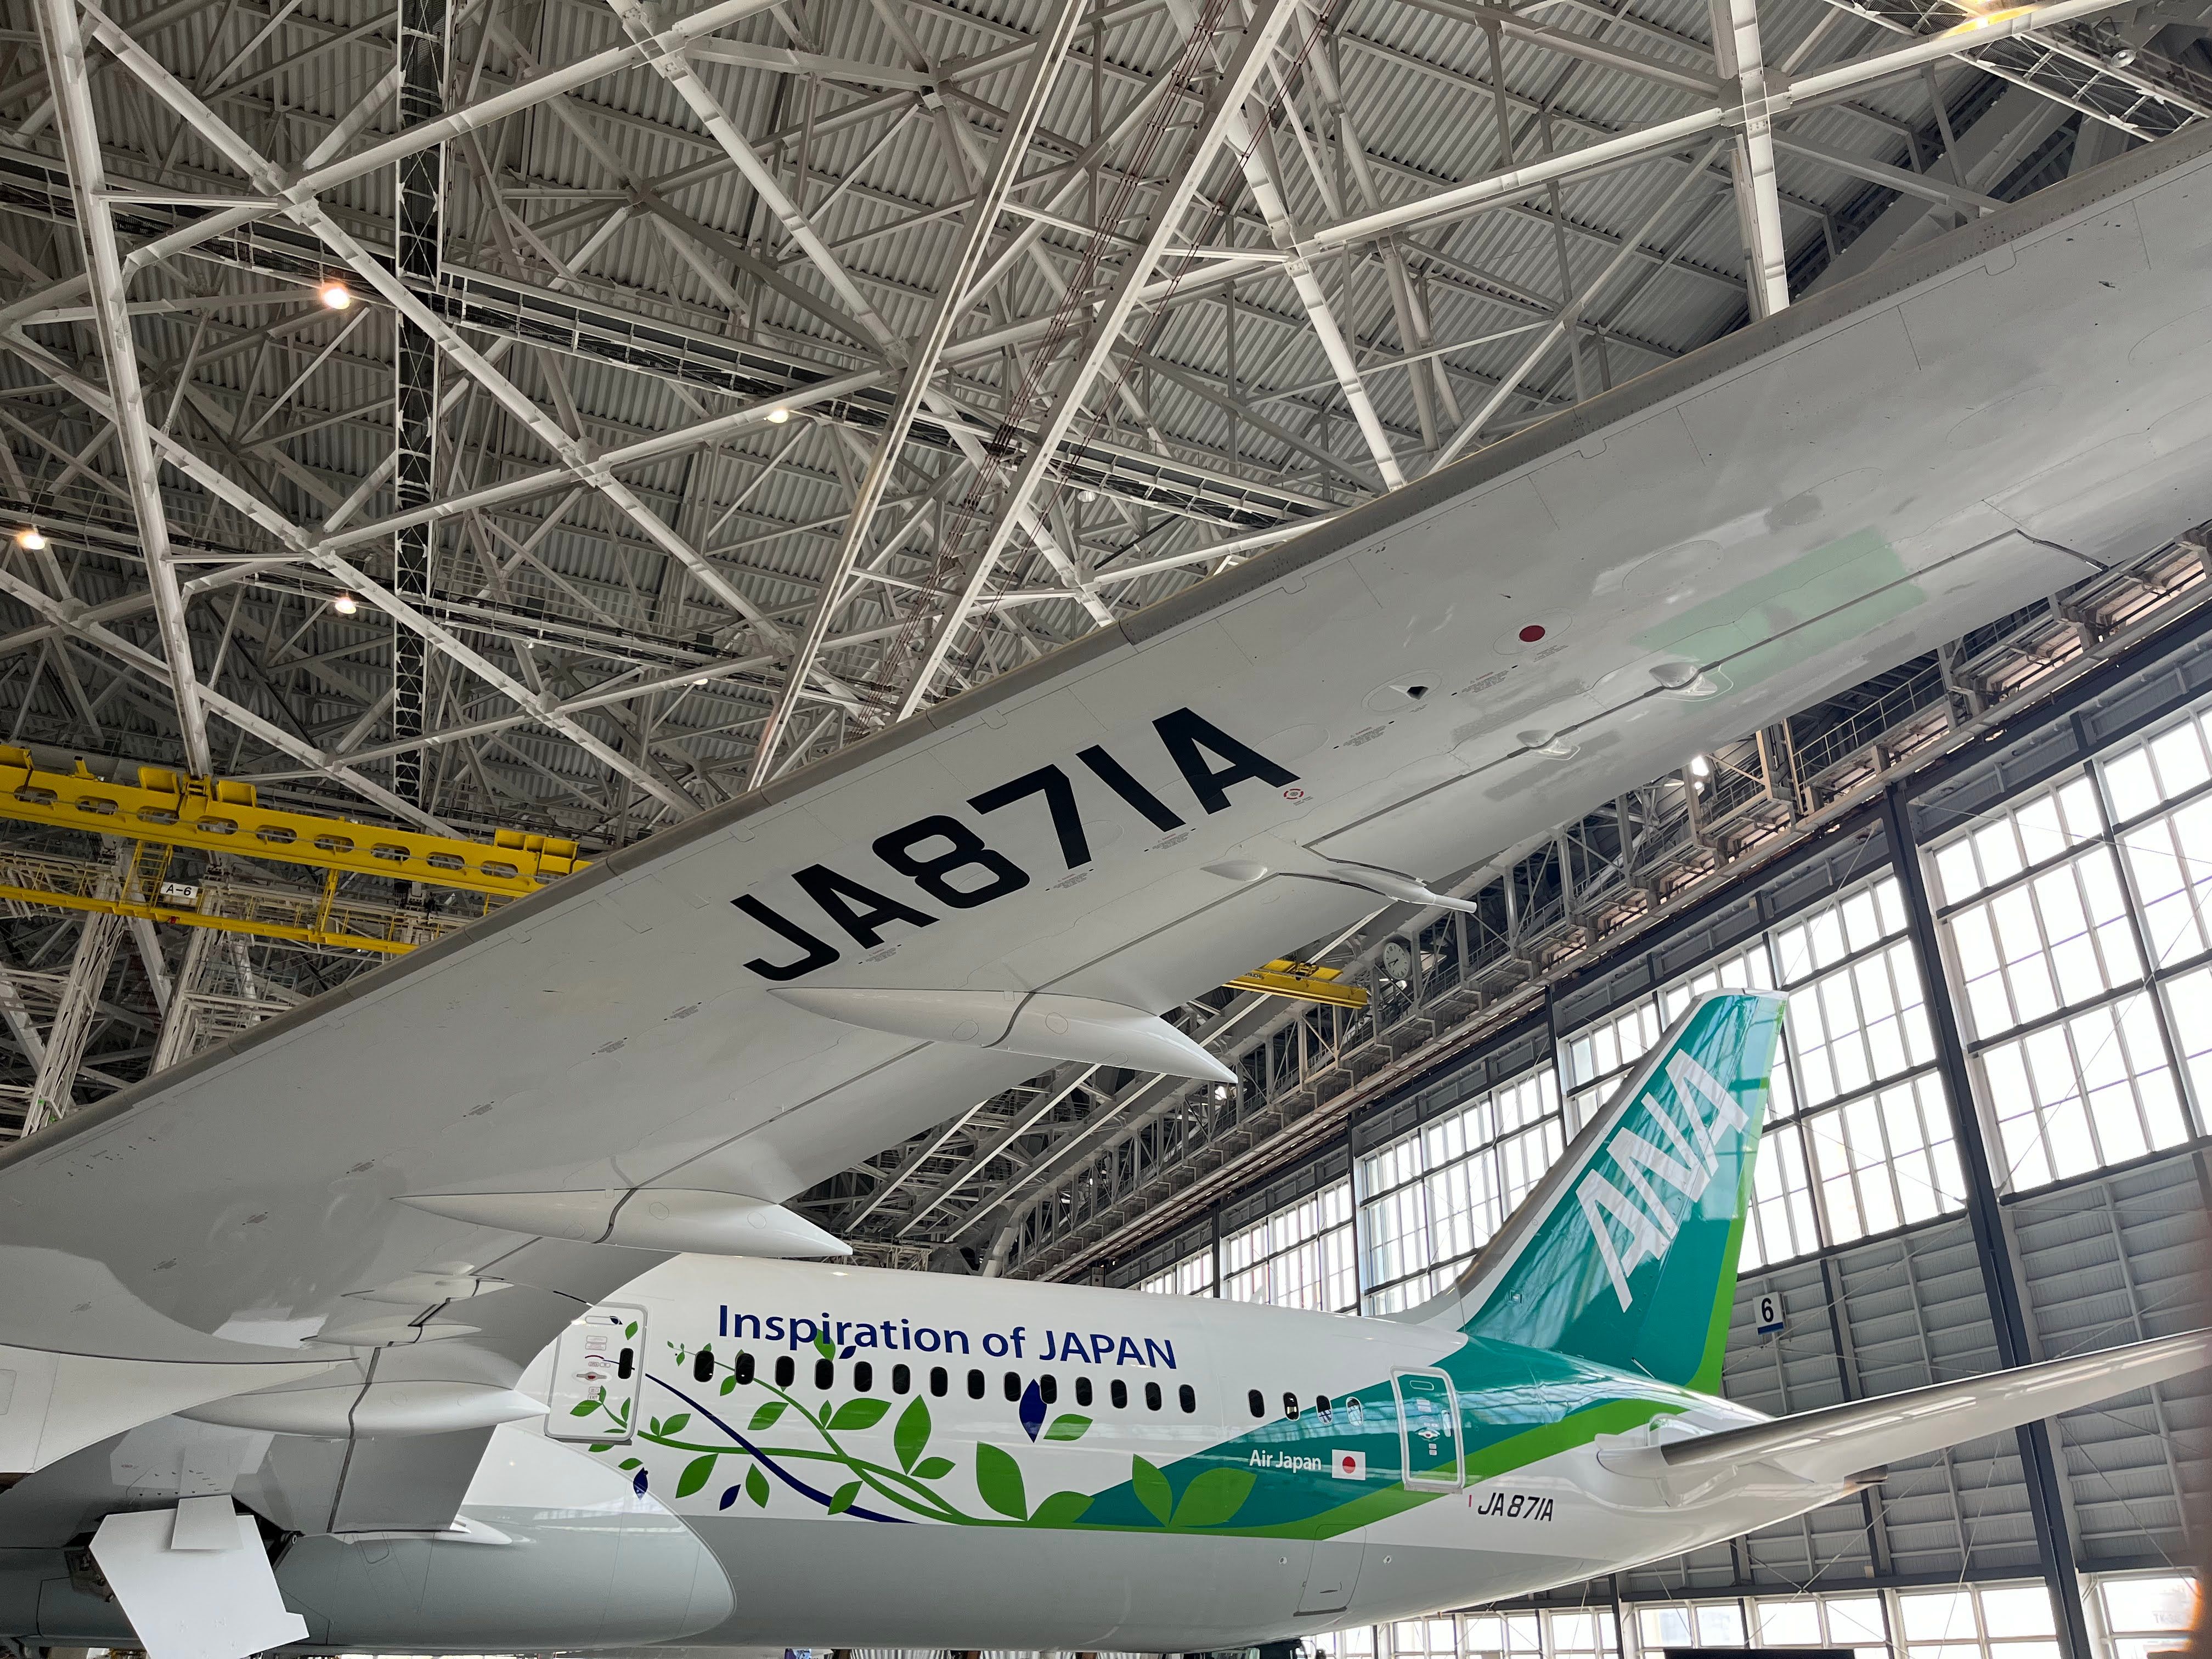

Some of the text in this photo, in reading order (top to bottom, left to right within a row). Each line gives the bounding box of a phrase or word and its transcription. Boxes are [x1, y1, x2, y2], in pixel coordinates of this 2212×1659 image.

[730, 707, 1301, 981] JA871A
[166, 884, 191, 895] A-6
[1576, 1048, 1749, 1312] ANA
[1762, 1298, 1775, 1323] 6
[720, 1305, 1177, 1369] Inspiration of JAPAN
[1250, 1450, 1321, 1473] Air Japan
[1478, 1493, 1553, 1521] JA871A
